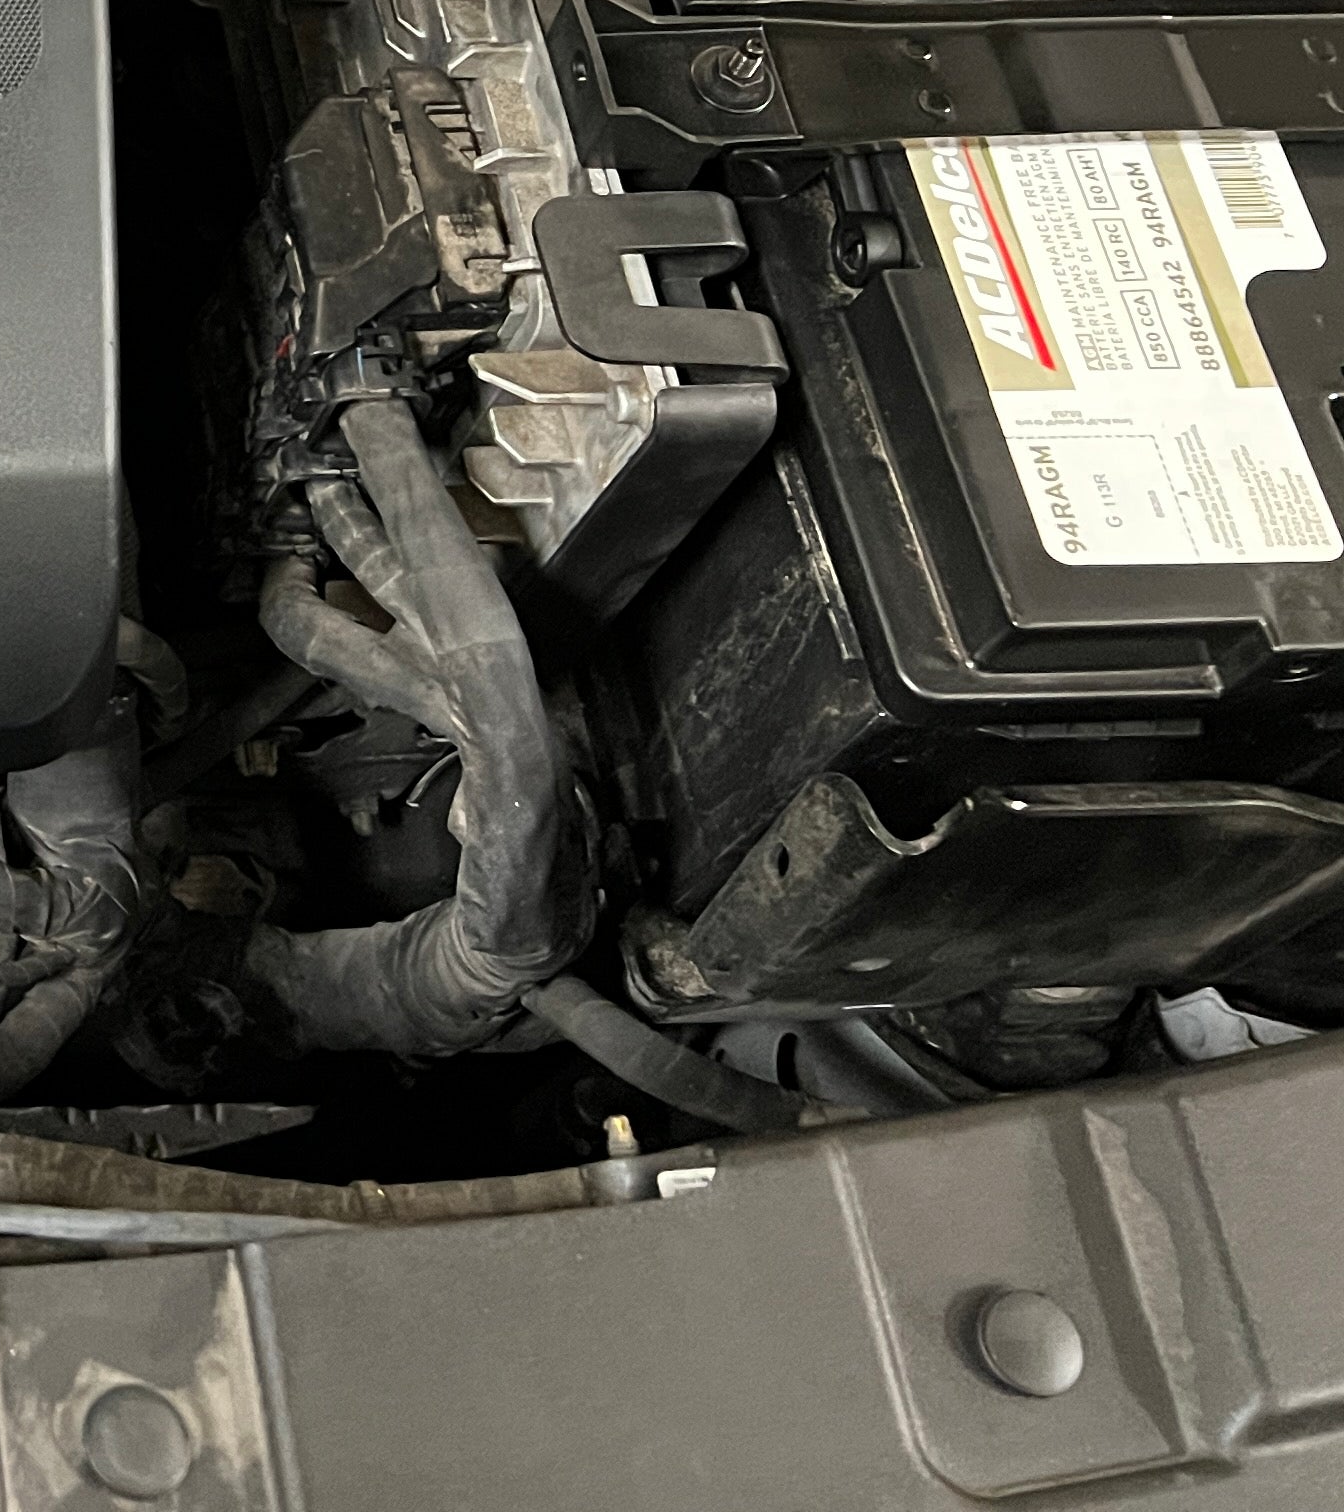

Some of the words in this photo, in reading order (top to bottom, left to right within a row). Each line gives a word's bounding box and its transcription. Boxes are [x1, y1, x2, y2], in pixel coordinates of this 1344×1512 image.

[1026, 152, 1045, 180] AGM
[1014, 168, 1041, 207] FREE
[1039, 147, 1083, 239] MANTENIMIEN
[1088, 184, 1108, 203] 80
[1121, 160, 1173, 247] 94RAGM
[1037, 185, 1076, 258] ENTRETIEN
[1103, 223, 1123, 243] RC
[1031, 214, 1085, 327] MAINTENANCE
[1075, 246, 1092, 262] DE
[1113, 248, 1136, 275] 140
[1067, 264, 1090, 298] SANS
[1083, 268, 1108, 307] LIBRE
[1131, 295, 1156, 327] CCA
[1161, 260, 1221, 370] 88864542
[1082, 305, 1118, 370] BATTERIE
[1144, 332, 1169, 362] 850
[1028, 445, 1088, 553] 94RAGM
[1092, 473, 1115, 505] 113R
[1104, 516, 1124, 527] G
